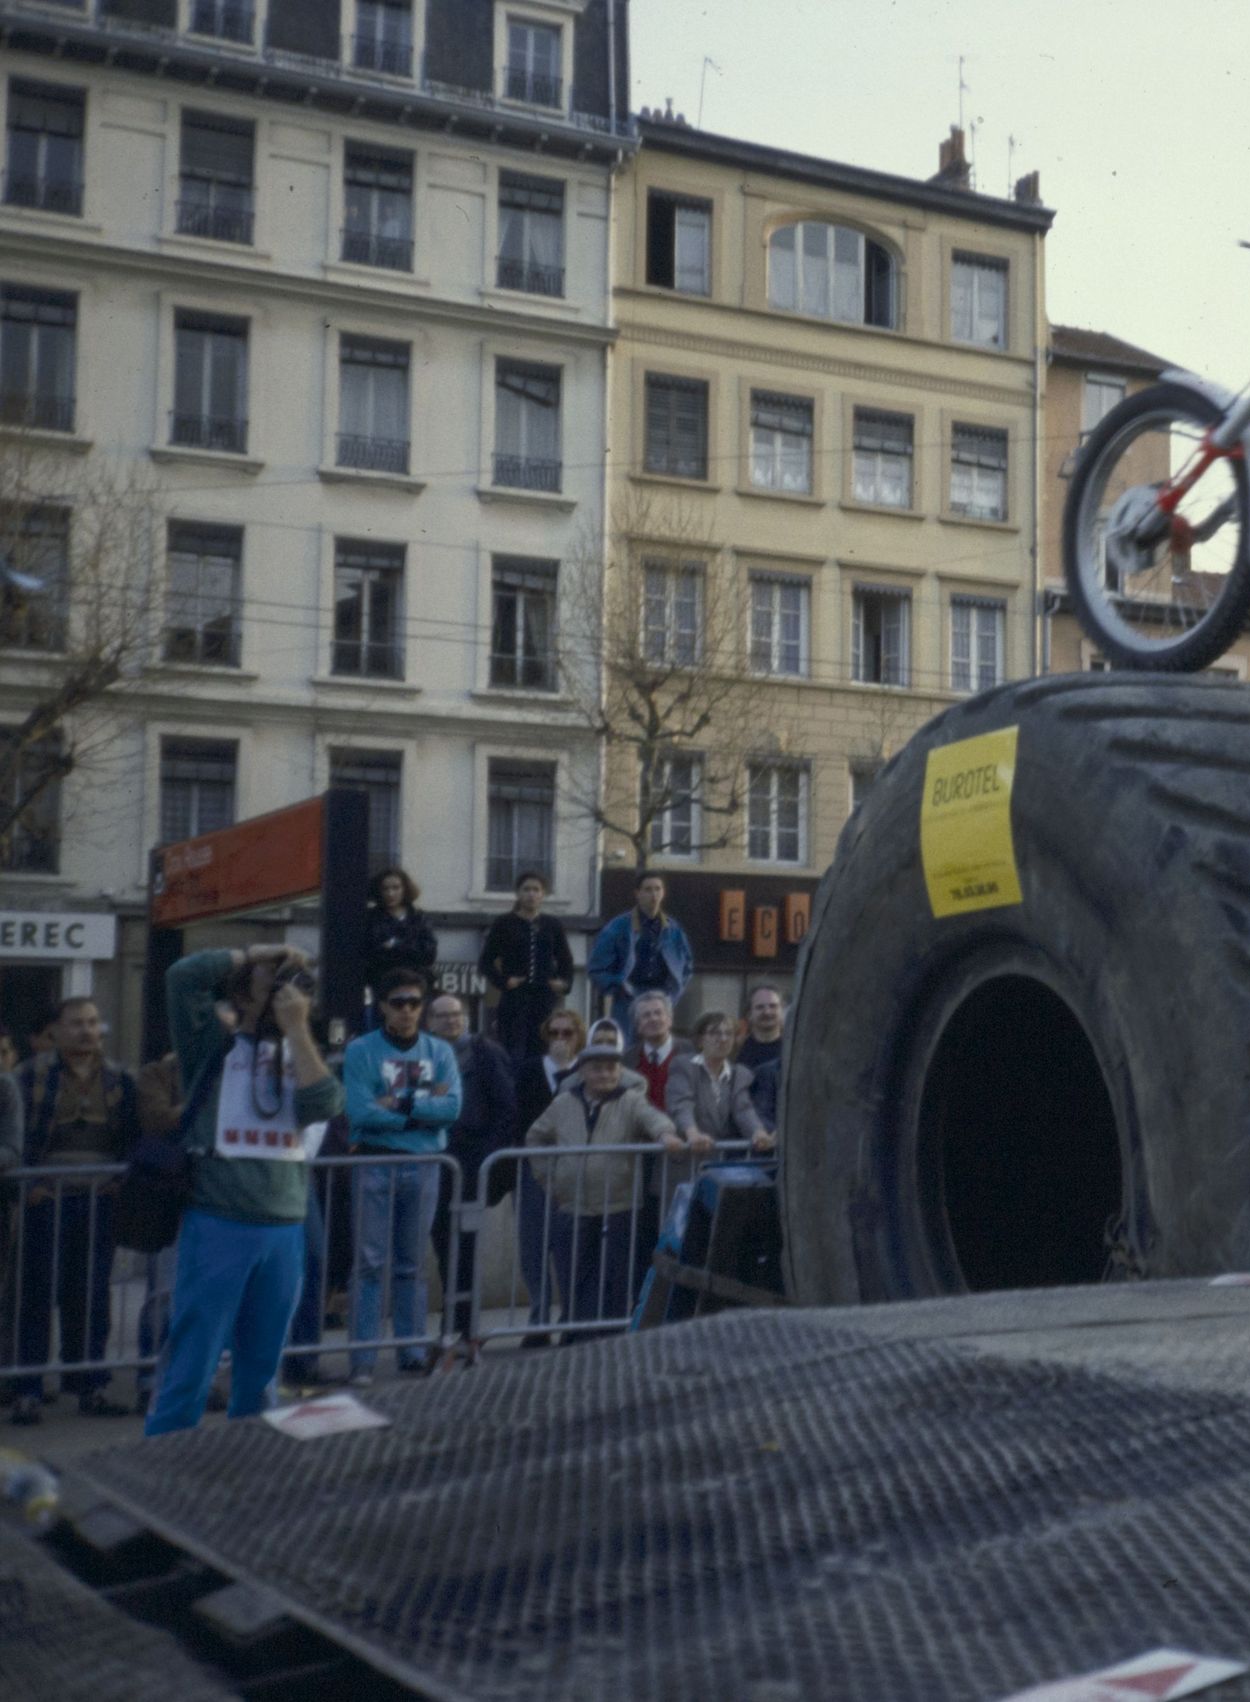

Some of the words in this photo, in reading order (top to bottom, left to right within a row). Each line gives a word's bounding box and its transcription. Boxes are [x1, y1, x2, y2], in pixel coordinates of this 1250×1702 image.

[932, 764, 999, 807] BUROTEL
[0, 921, 85, 949] EREC
[433, 973, 487, 994] BIN
